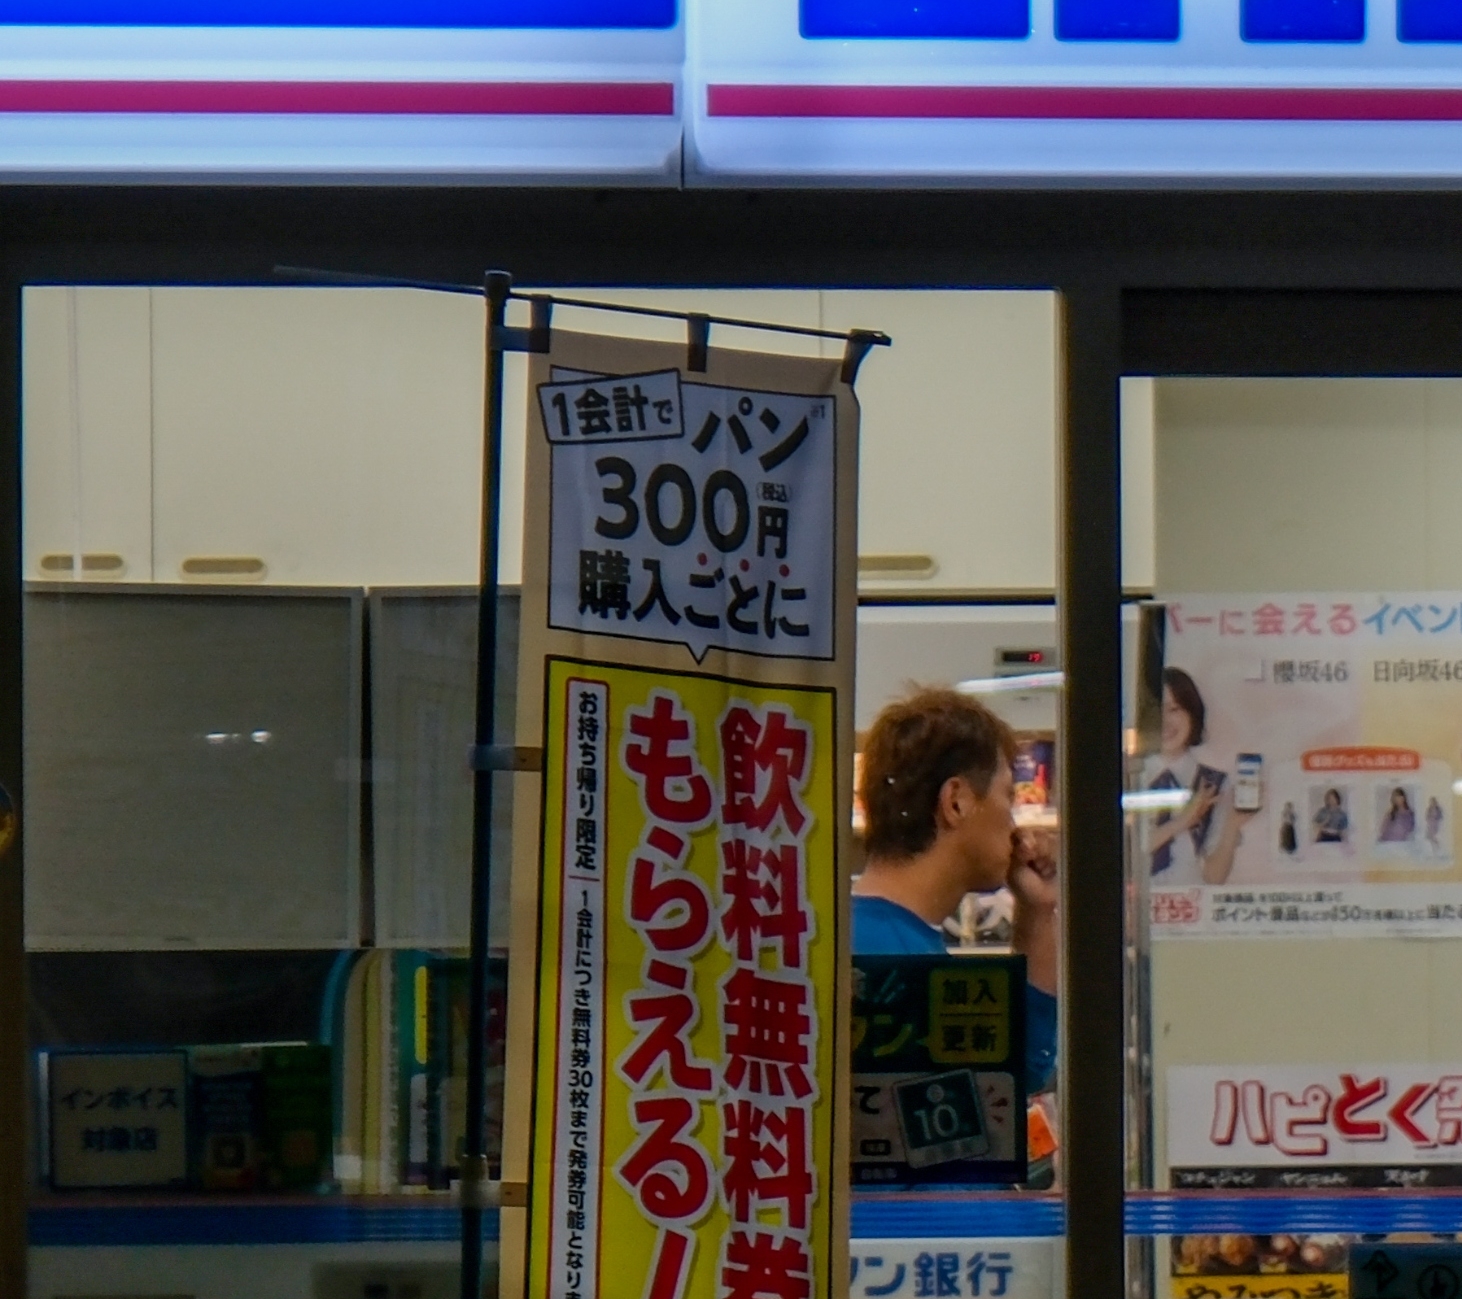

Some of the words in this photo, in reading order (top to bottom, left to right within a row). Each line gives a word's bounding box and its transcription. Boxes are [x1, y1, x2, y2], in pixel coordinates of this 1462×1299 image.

[552, 384, 674, 437] 1会計で
[692, 397, 810, 472] パン
[594, 456, 789, 560] 300円
[579, 550, 810, 639] 購入ごとに
[575, 691, 598, 870] お持ち帰り限定
[61, 1084, 178, 1112] インボイス
[82, 1127, 157, 1152] 対象店
[850, 1251, 1014, 1297] ン銀行
